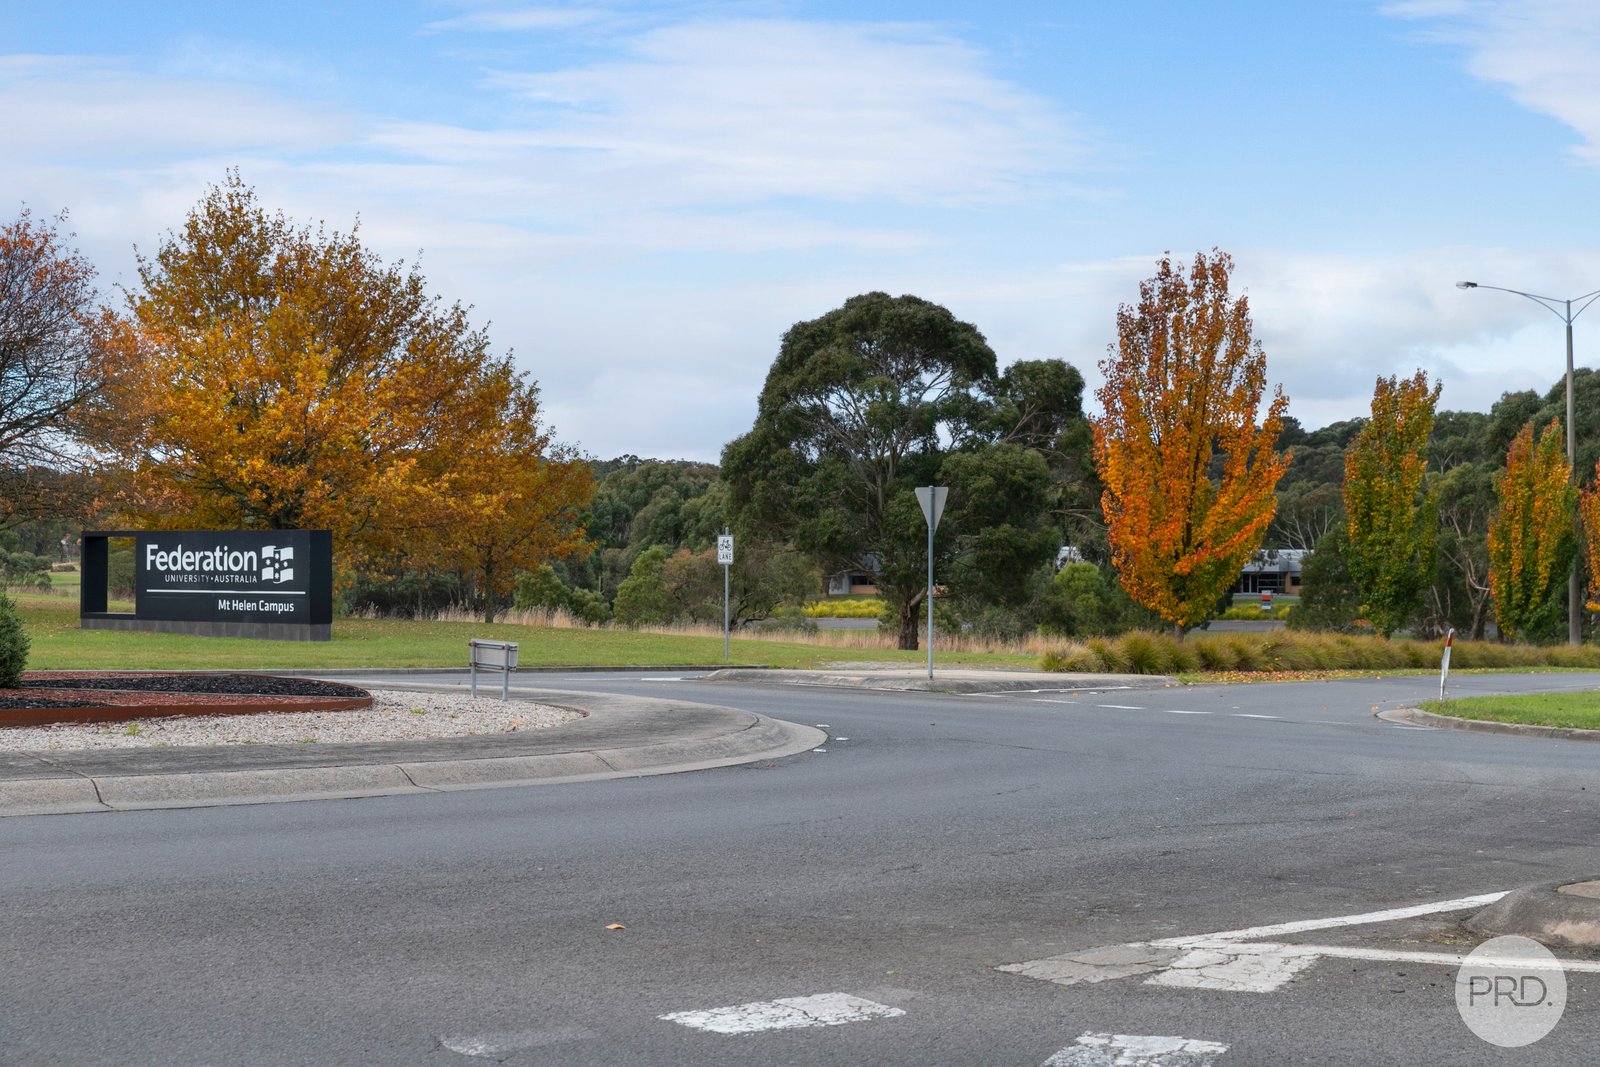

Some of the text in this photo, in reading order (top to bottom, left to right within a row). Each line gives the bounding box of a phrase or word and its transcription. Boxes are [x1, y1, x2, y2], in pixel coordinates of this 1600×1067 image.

[146, 544, 257, 571] Federation
[218, 599, 294, 614] Mt Helen Campus
